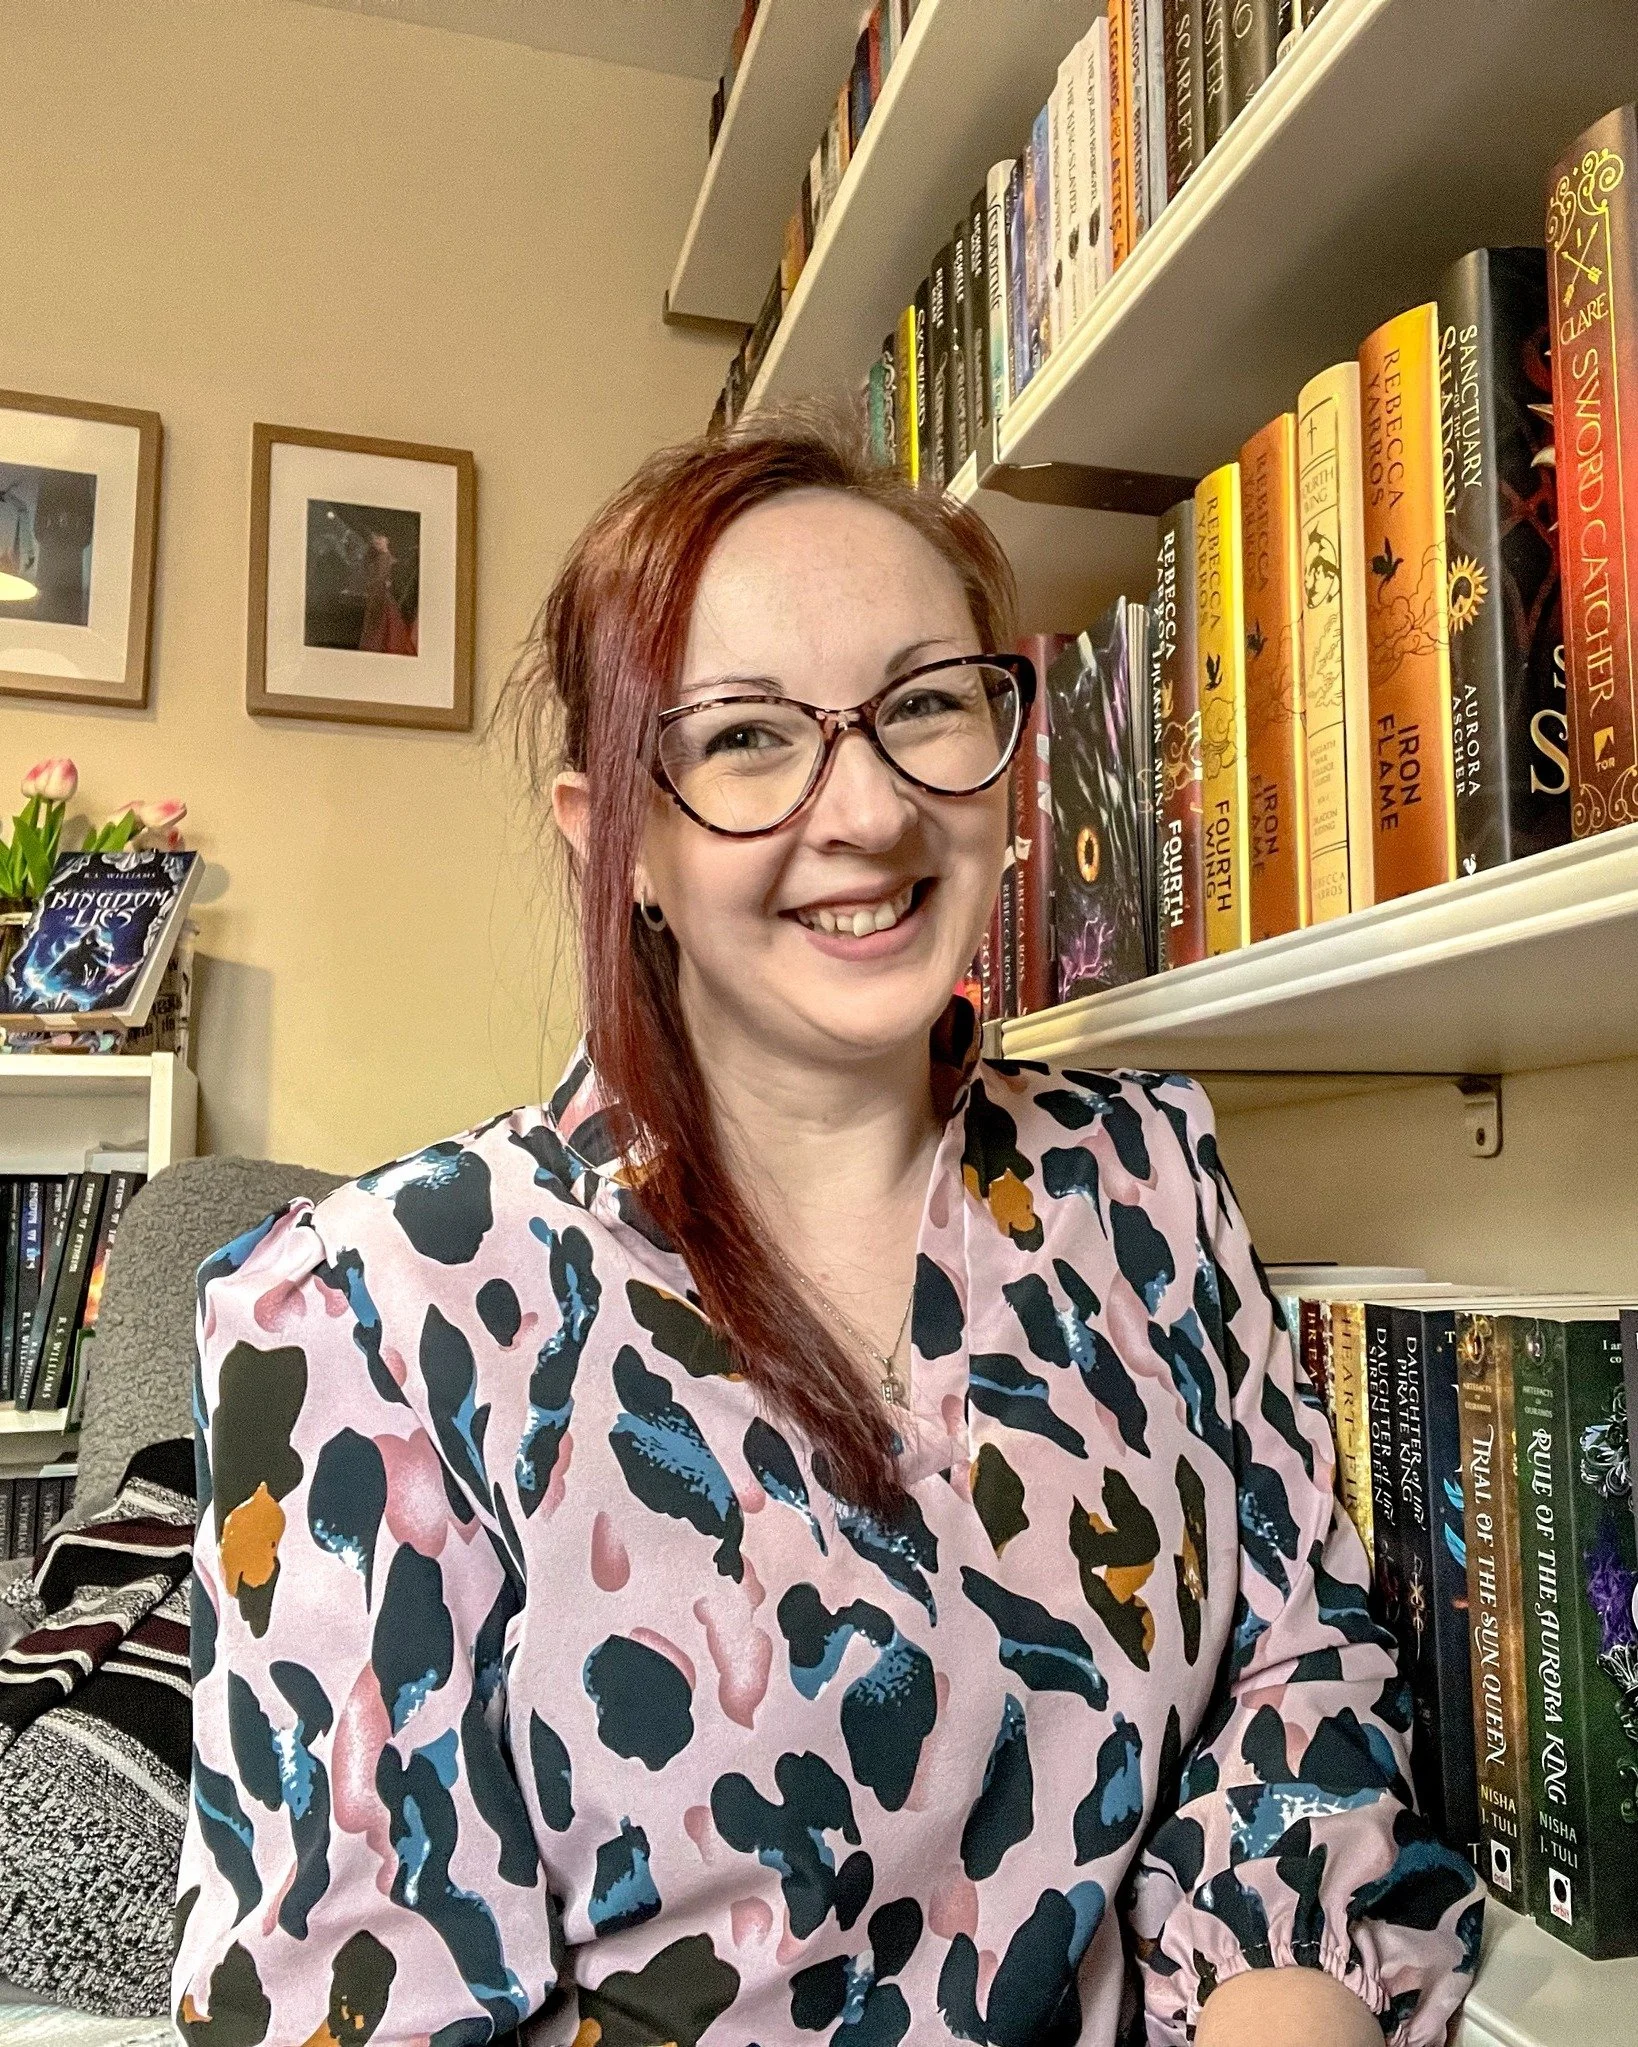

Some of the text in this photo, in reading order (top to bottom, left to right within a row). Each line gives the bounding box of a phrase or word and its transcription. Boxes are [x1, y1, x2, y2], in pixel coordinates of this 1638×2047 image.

[1175, 13, 1193, 152] SCARLET
[1560, 292, 1609, 346] CLARE
[1367, 372, 1384, 507] YARROS
[1383, 347, 1405, 510] REBECCA
[1438, 325, 1457, 515] SHADOW
[1459, 324, 1483, 489] SANCTUARY
[1206, 496, 1222, 630] REBECCA
[1256, 452, 1270, 592] REBECCA
[1572, 348, 1615, 719] SWORD CATCHER
[1163, 530, 1177, 661] REBECCA
[1377, 712, 1399, 833] FLAME
[1397, 723, 1422, 807] IRON
[1452, 696, 1466, 798] ASCHER
[1464, 684, 1481, 797] AURORA
[1596, 757, 1615, 773] TOR
[1168, 819, 1184, 928] FOURTH
[1205, 823, 1217, 900] WING
[1214, 799, 1232, 912] FOURTH
[1250, 774, 1265, 877] FLAME
[1263, 783, 1279, 857] IRON
[50, 889, 171, 911] KINGDOM
[70, 907, 137, 928] LIES
[1017, 870, 1026, 983] REBECCA ROSS
[1162, 846, 1171, 915] WING
[1003, 883, 1012, 992] REBECCA ROSS
[20, 1358, 35, 1400] WILLIAMS
[42, 1341, 62, 1399] WILLIAMS
[1376, 1328, 1392, 1457] DAUGHTER
[1406, 1336, 1423, 1467] DAUGHTER
[1533, 1342, 1541, 1357] 2
[1369, 1345, 1384, 1505] SIREN QUEEN
[1397, 1358, 1414, 1504] PIRATE KING
[1470, 1423, 1507, 1767] TRIAL OF THE SUN QUEEN
[1528, 1427, 1568, 1806] RULE OF THE AURORA KING
[1480, 1784, 1517, 1815] NISHA
[1491, 1811, 1518, 1838] TULI
[1539, 1810, 1578, 1845] NISHA
[1550, 1840, 1579, 1870] TULI
[1552, 1903, 1570, 1919] orbit
